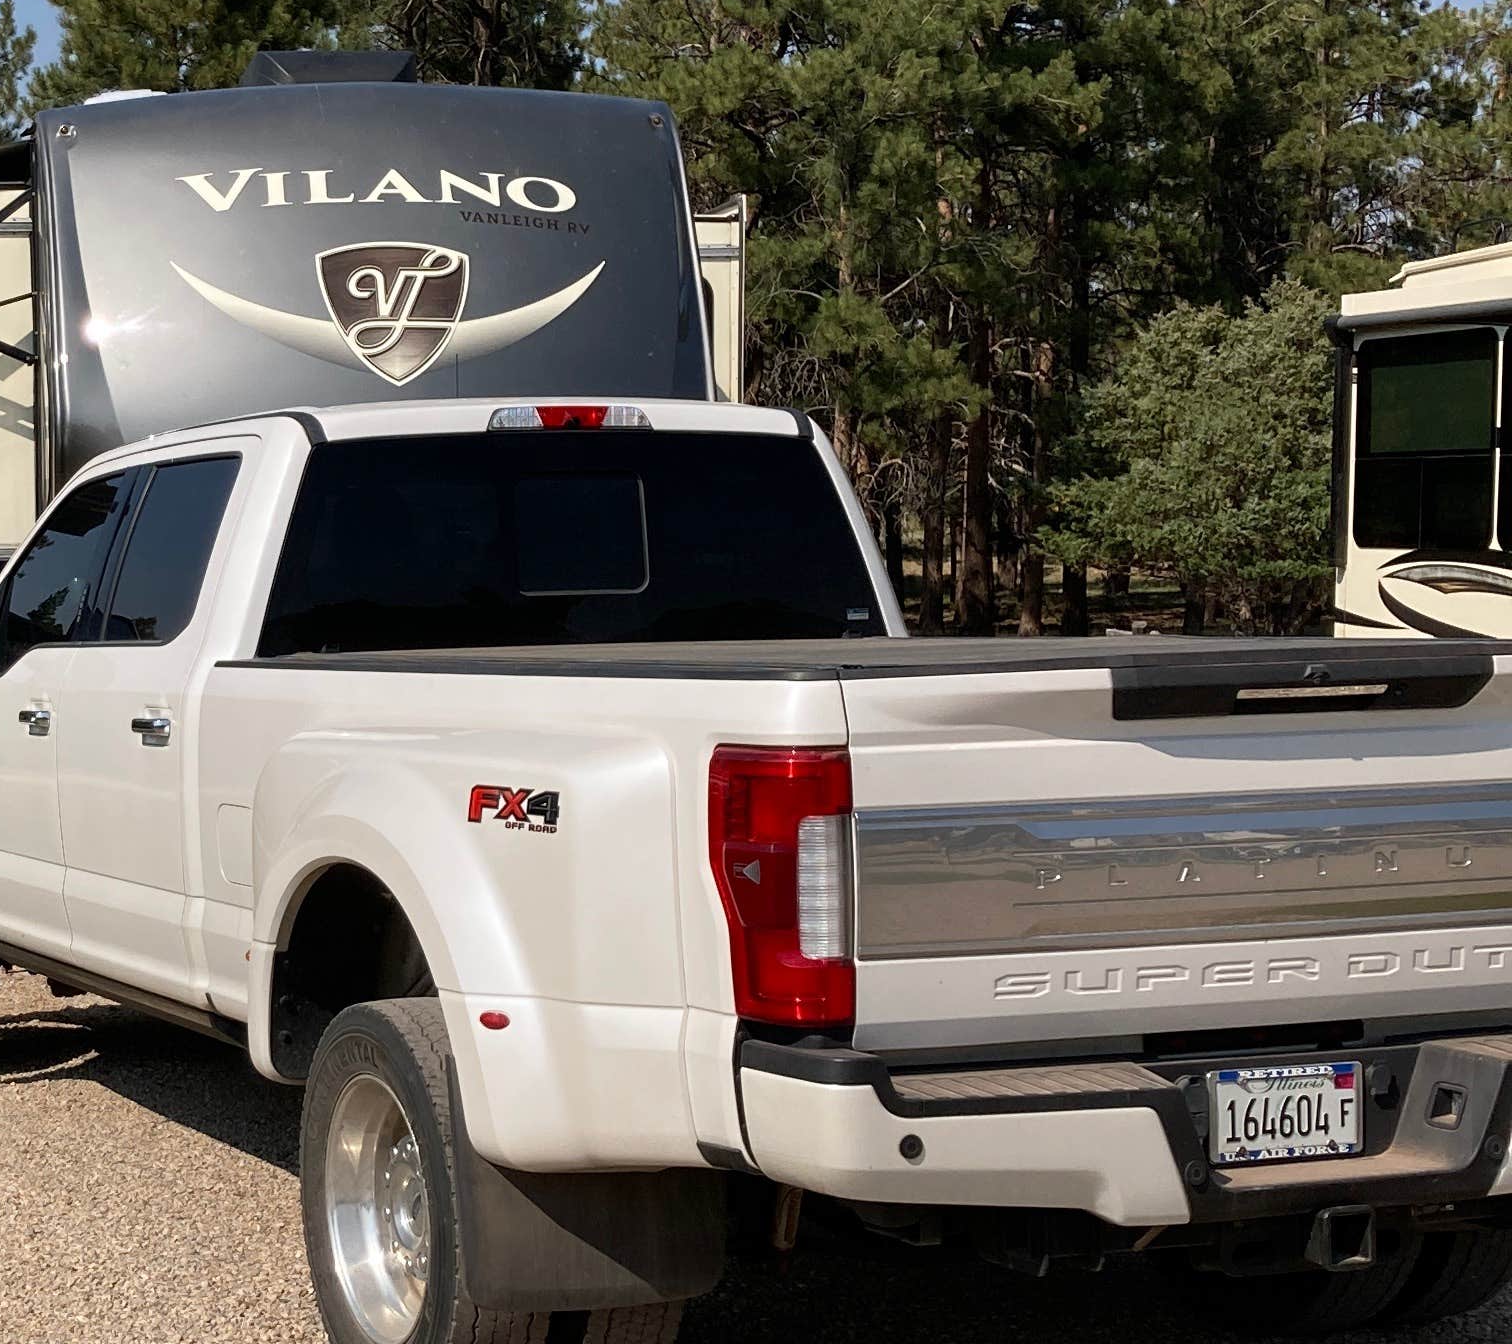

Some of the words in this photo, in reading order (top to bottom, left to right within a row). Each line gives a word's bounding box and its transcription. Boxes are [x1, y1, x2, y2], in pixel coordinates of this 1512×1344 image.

[175, 167, 577, 213] VILANO
[460, 210, 559, 231] VANLEIGH
[567, 222, 591, 235] RV
[467, 784, 560, 825] FX4
[504, 822, 525, 830] OFF
[528, 824, 558, 834] ROAD
[993, 956, 1319, 1000] SUPER
[1238, 1065, 1335, 1079] RETIRED
[1248, 1076, 1325, 1094] Illinois
[1226, 1093, 1330, 1144] 164604
[1340, 1098, 1354, 1127] F
[1257, 1147, 1289, 1160] AIR
[1293, 1143, 1350, 1157] FORCE
